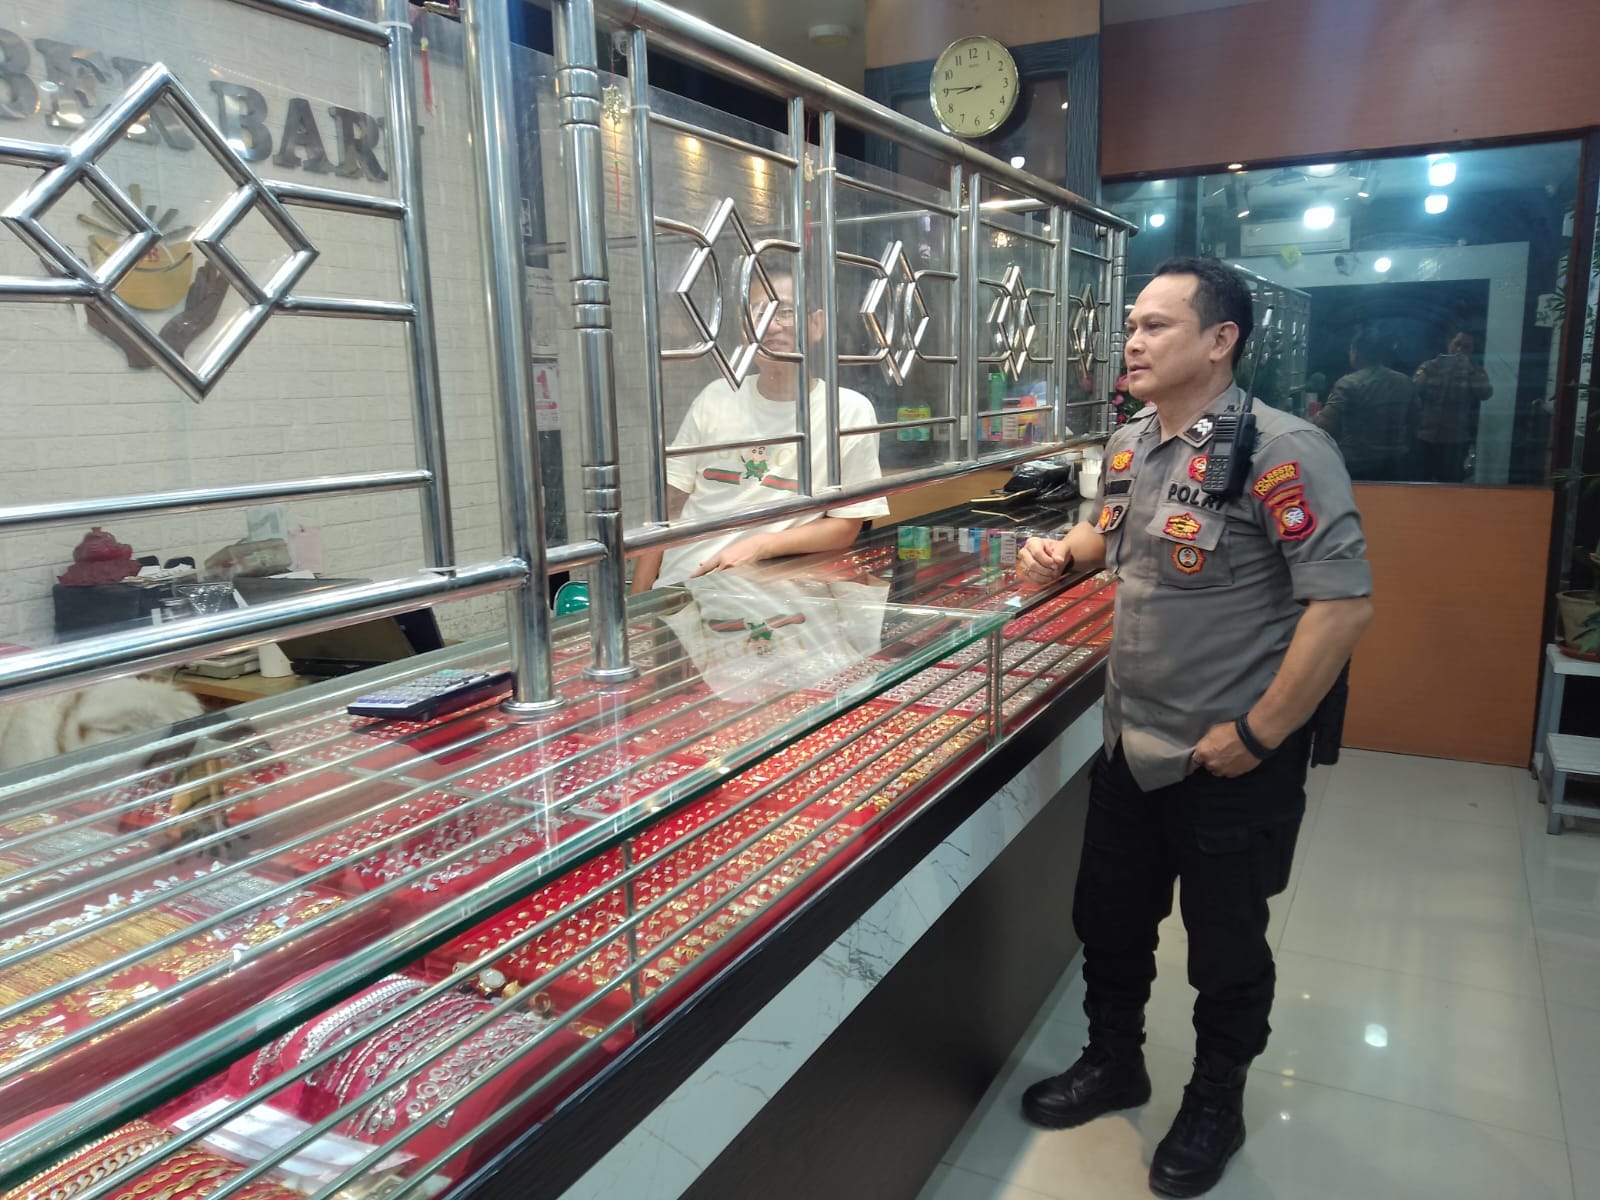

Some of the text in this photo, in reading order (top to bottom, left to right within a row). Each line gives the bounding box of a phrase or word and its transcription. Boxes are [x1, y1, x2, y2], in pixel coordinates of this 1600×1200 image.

[968, 48, 978, 59] 12
[955, 56, 962, 66] 11
[998, 60, 1004, 71] 2
[945, 70, 953, 80] 10
[1003, 77, 1009, 88] 3
[943, 88, 949, 97] 9
[999, 96, 1005, 105] 4
[948, 103, 954, 113] 8
[960, 113, 965, 124] 7
[990, 109, 995, 120] 5
[974, 115, 980, 126] 6
[209, 79, 424, 183] BAR
